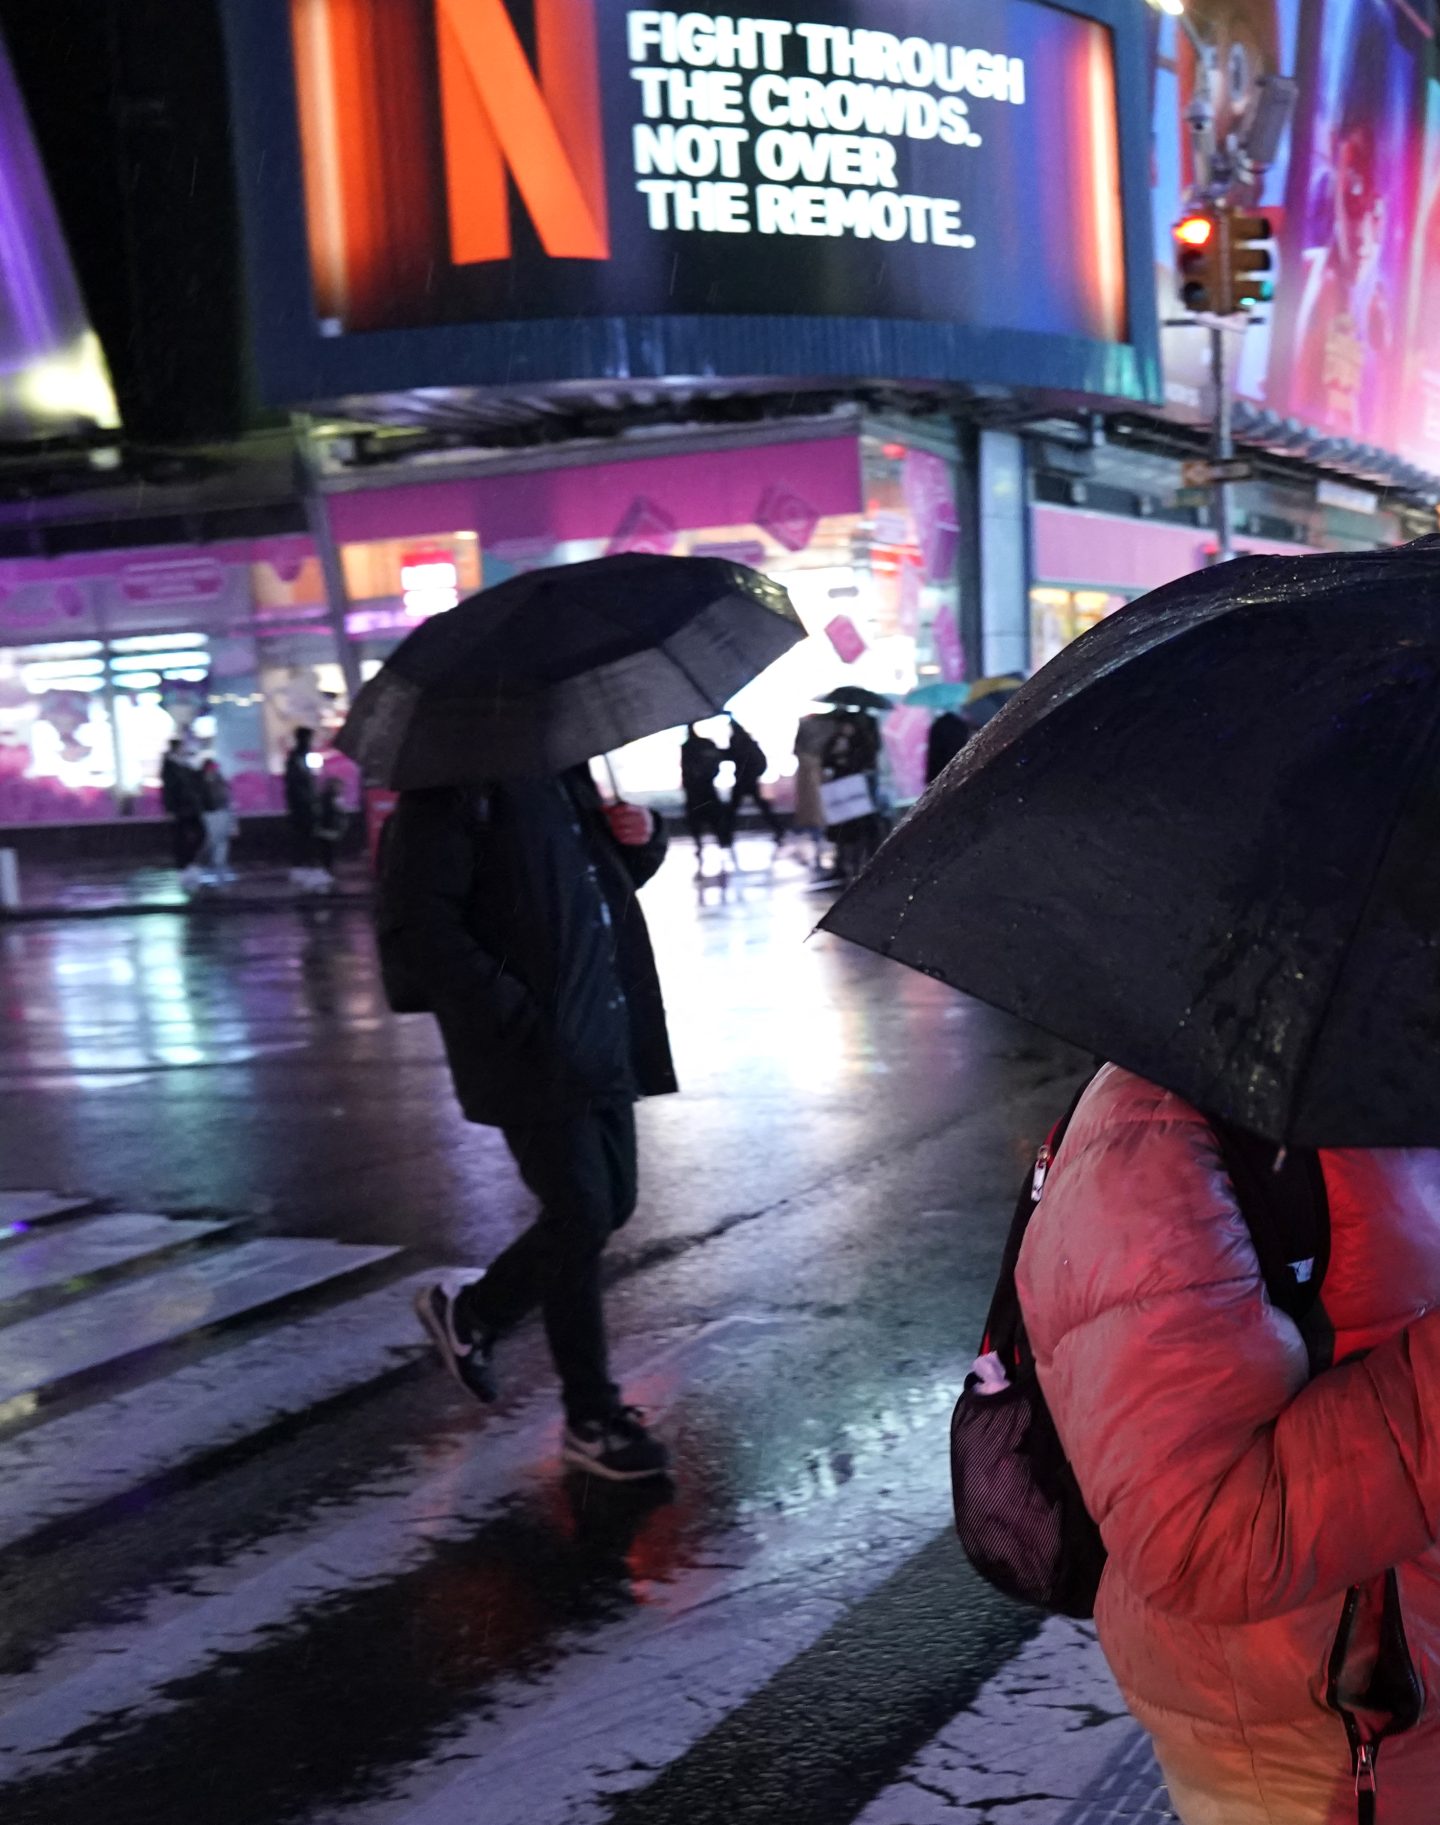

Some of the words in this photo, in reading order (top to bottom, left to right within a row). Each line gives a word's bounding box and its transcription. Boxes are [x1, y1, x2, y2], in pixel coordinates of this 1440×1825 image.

[626, 10, 792, 71] FIGHT
[796, 22, 1026, 105] THROUGH
[434, 0, 611, 265] N
[629, 66, 745, 124] THE
[749, 73, 983, 148] CROWDS.
[632, 123, 750, 178] NOT
[754, 129, 898, 189] OVER
[636, 178, 751, 234] THE
[754, 183, 976, 249] REMOTE.
